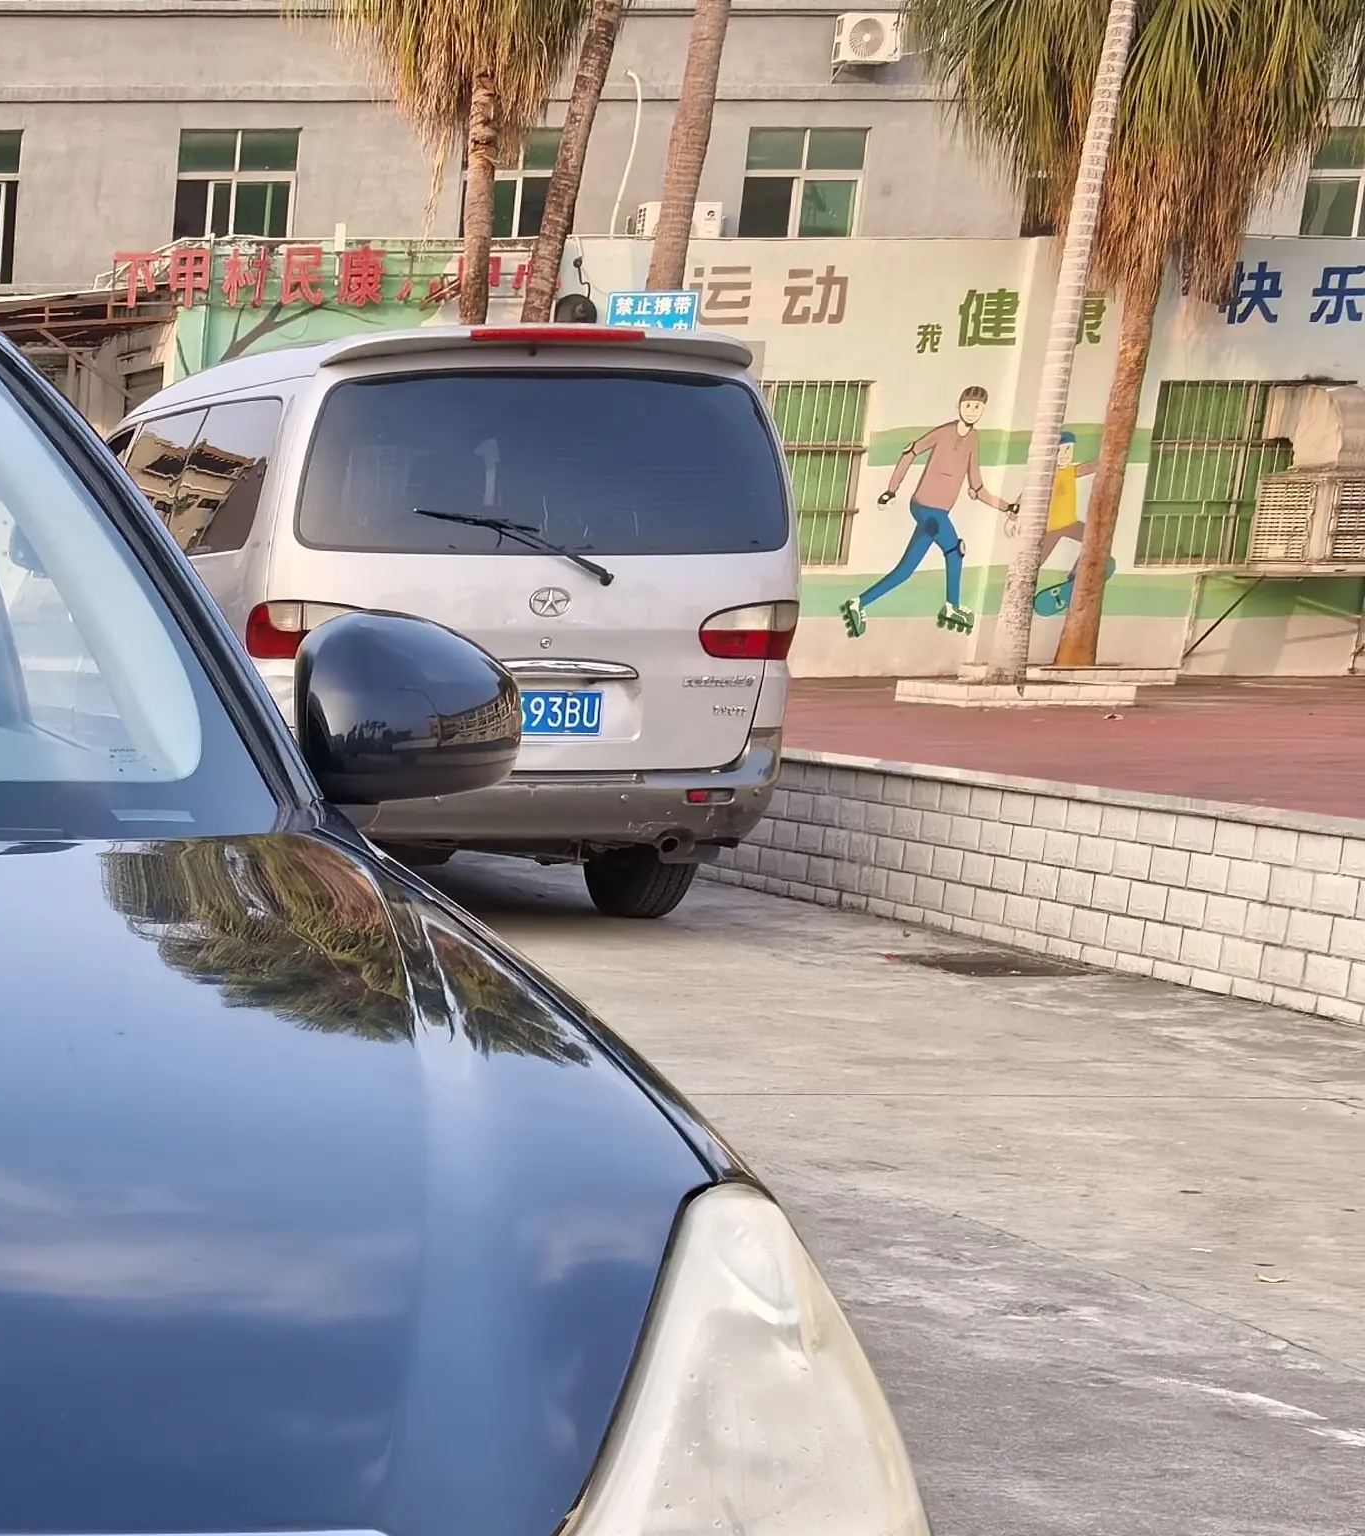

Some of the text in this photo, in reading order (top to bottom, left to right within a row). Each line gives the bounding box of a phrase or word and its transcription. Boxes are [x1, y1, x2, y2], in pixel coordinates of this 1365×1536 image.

[113, 245, 561, 307] 下甲村民康
[615, 295, 692, 315] 禁止携带
[689, 265, 849, 325] 运动
[1218, 260, 1365, 324] 快乐
